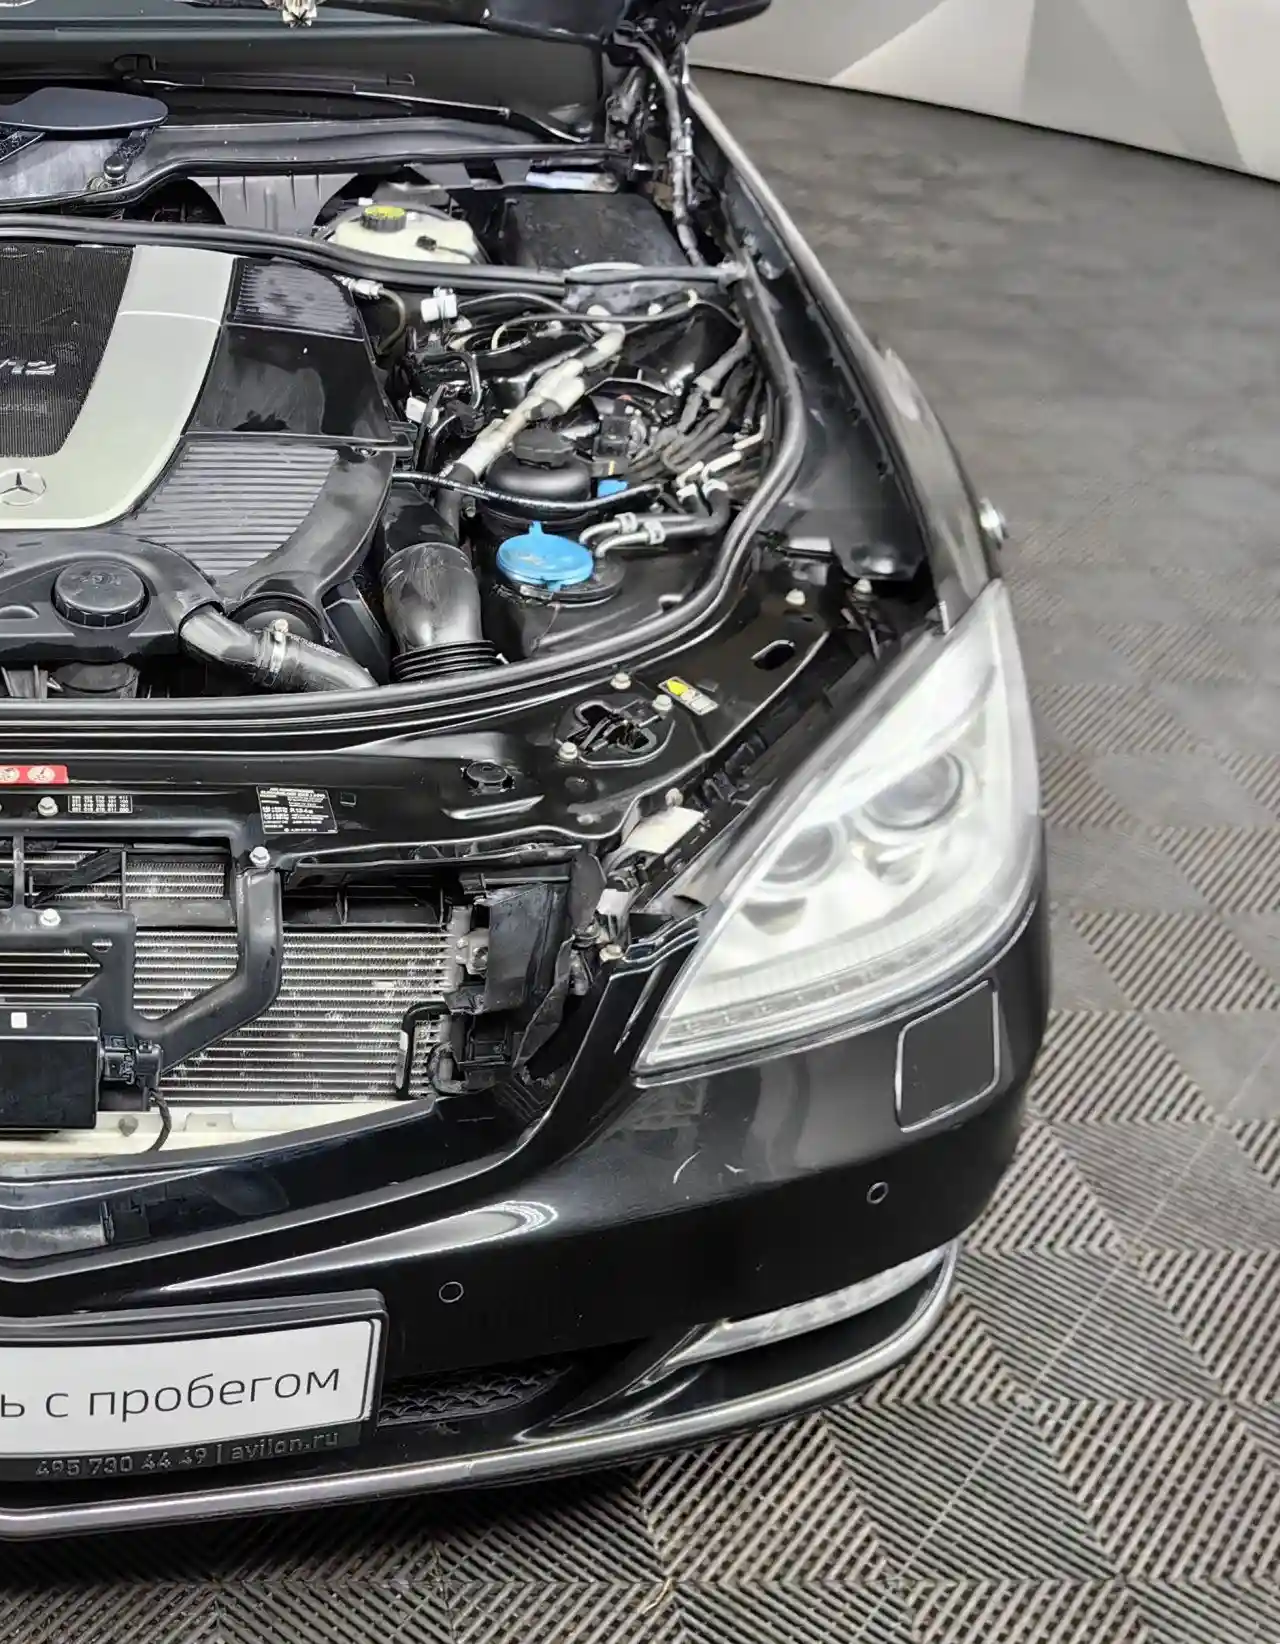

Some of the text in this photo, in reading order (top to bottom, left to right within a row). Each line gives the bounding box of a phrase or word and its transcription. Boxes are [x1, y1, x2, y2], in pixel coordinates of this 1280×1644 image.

[45, 1392, 69, 1418] с
[89, 1368, 340, 1423] пробегом
[89, 1455, 133, 1475] 730
